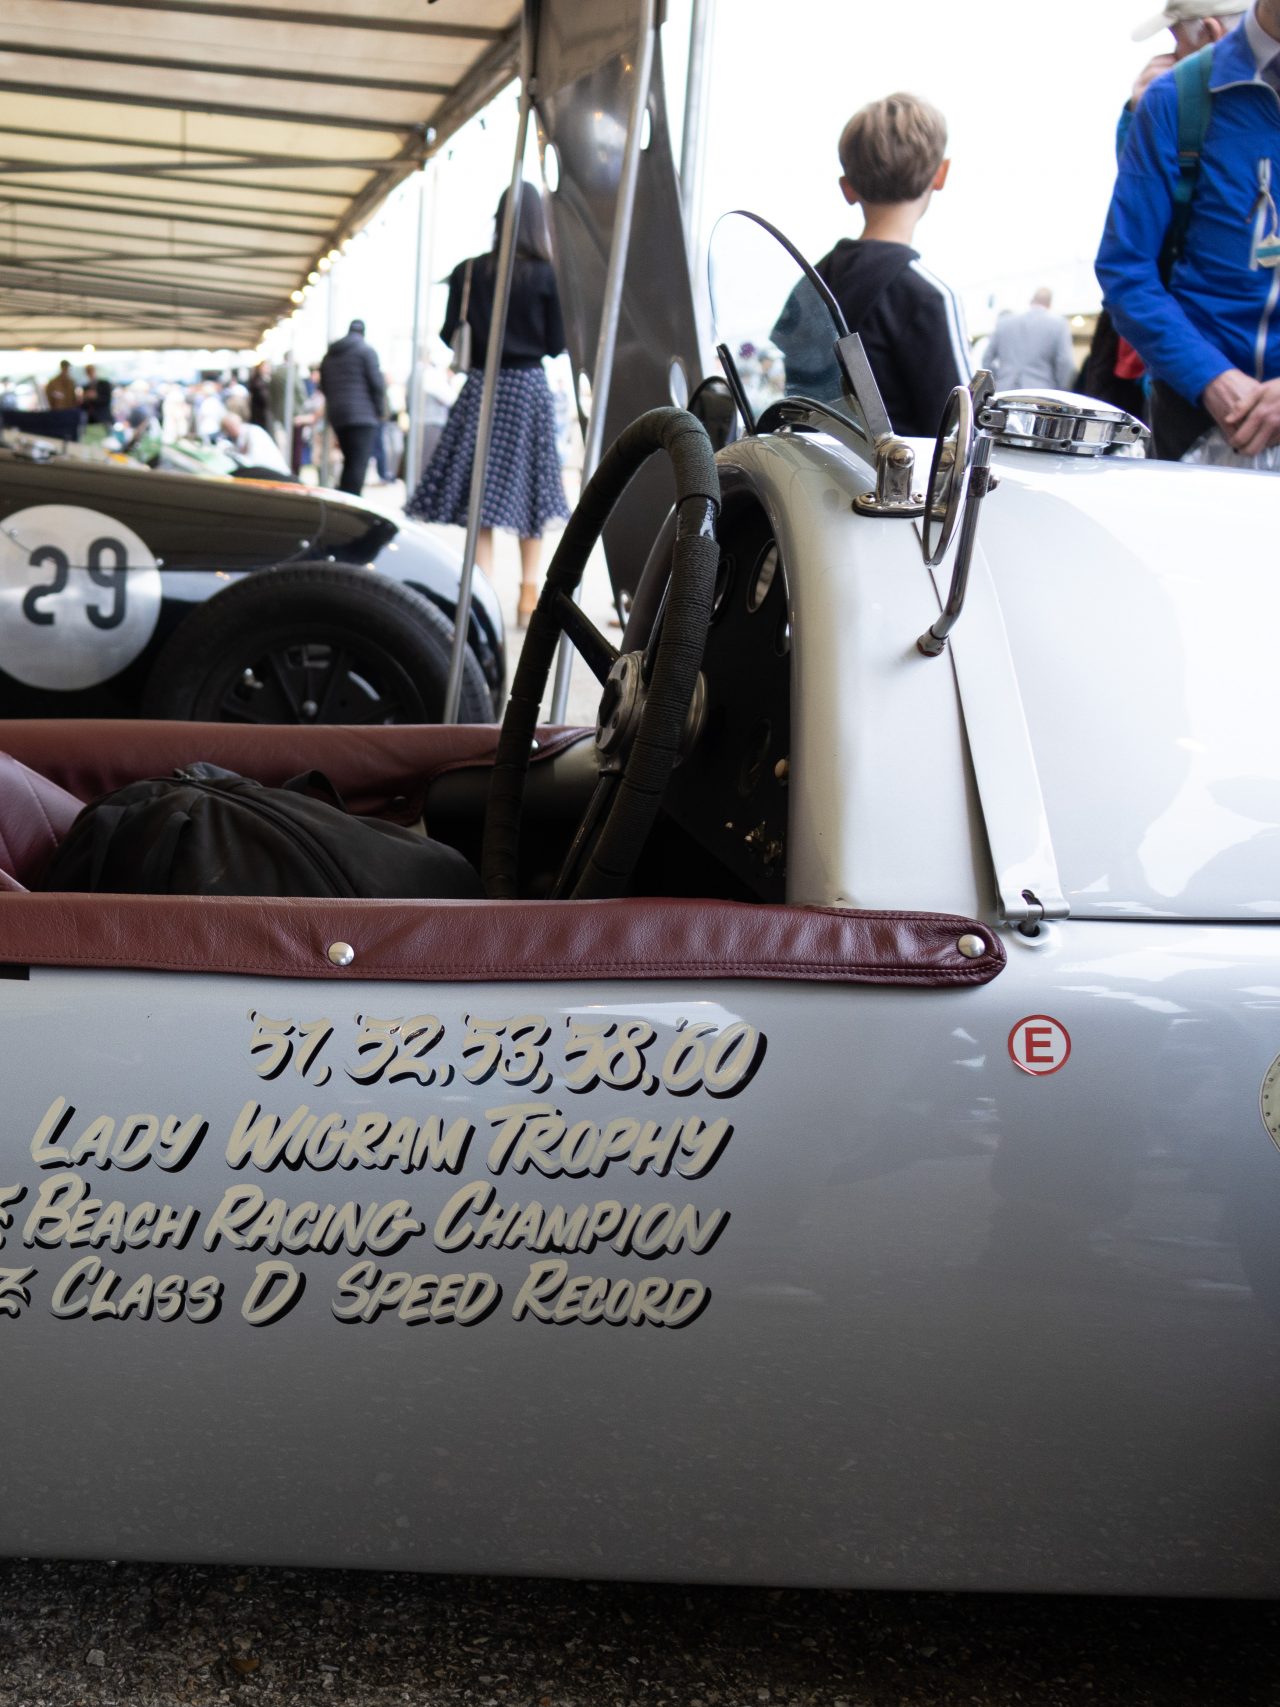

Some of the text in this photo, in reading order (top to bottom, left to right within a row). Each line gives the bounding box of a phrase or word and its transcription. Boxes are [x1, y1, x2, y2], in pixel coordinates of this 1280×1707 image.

[23, 536, 128, 630] 29
[1025, 1027, 1054, 1063] E
[241, 1260, 307, 1327] D
